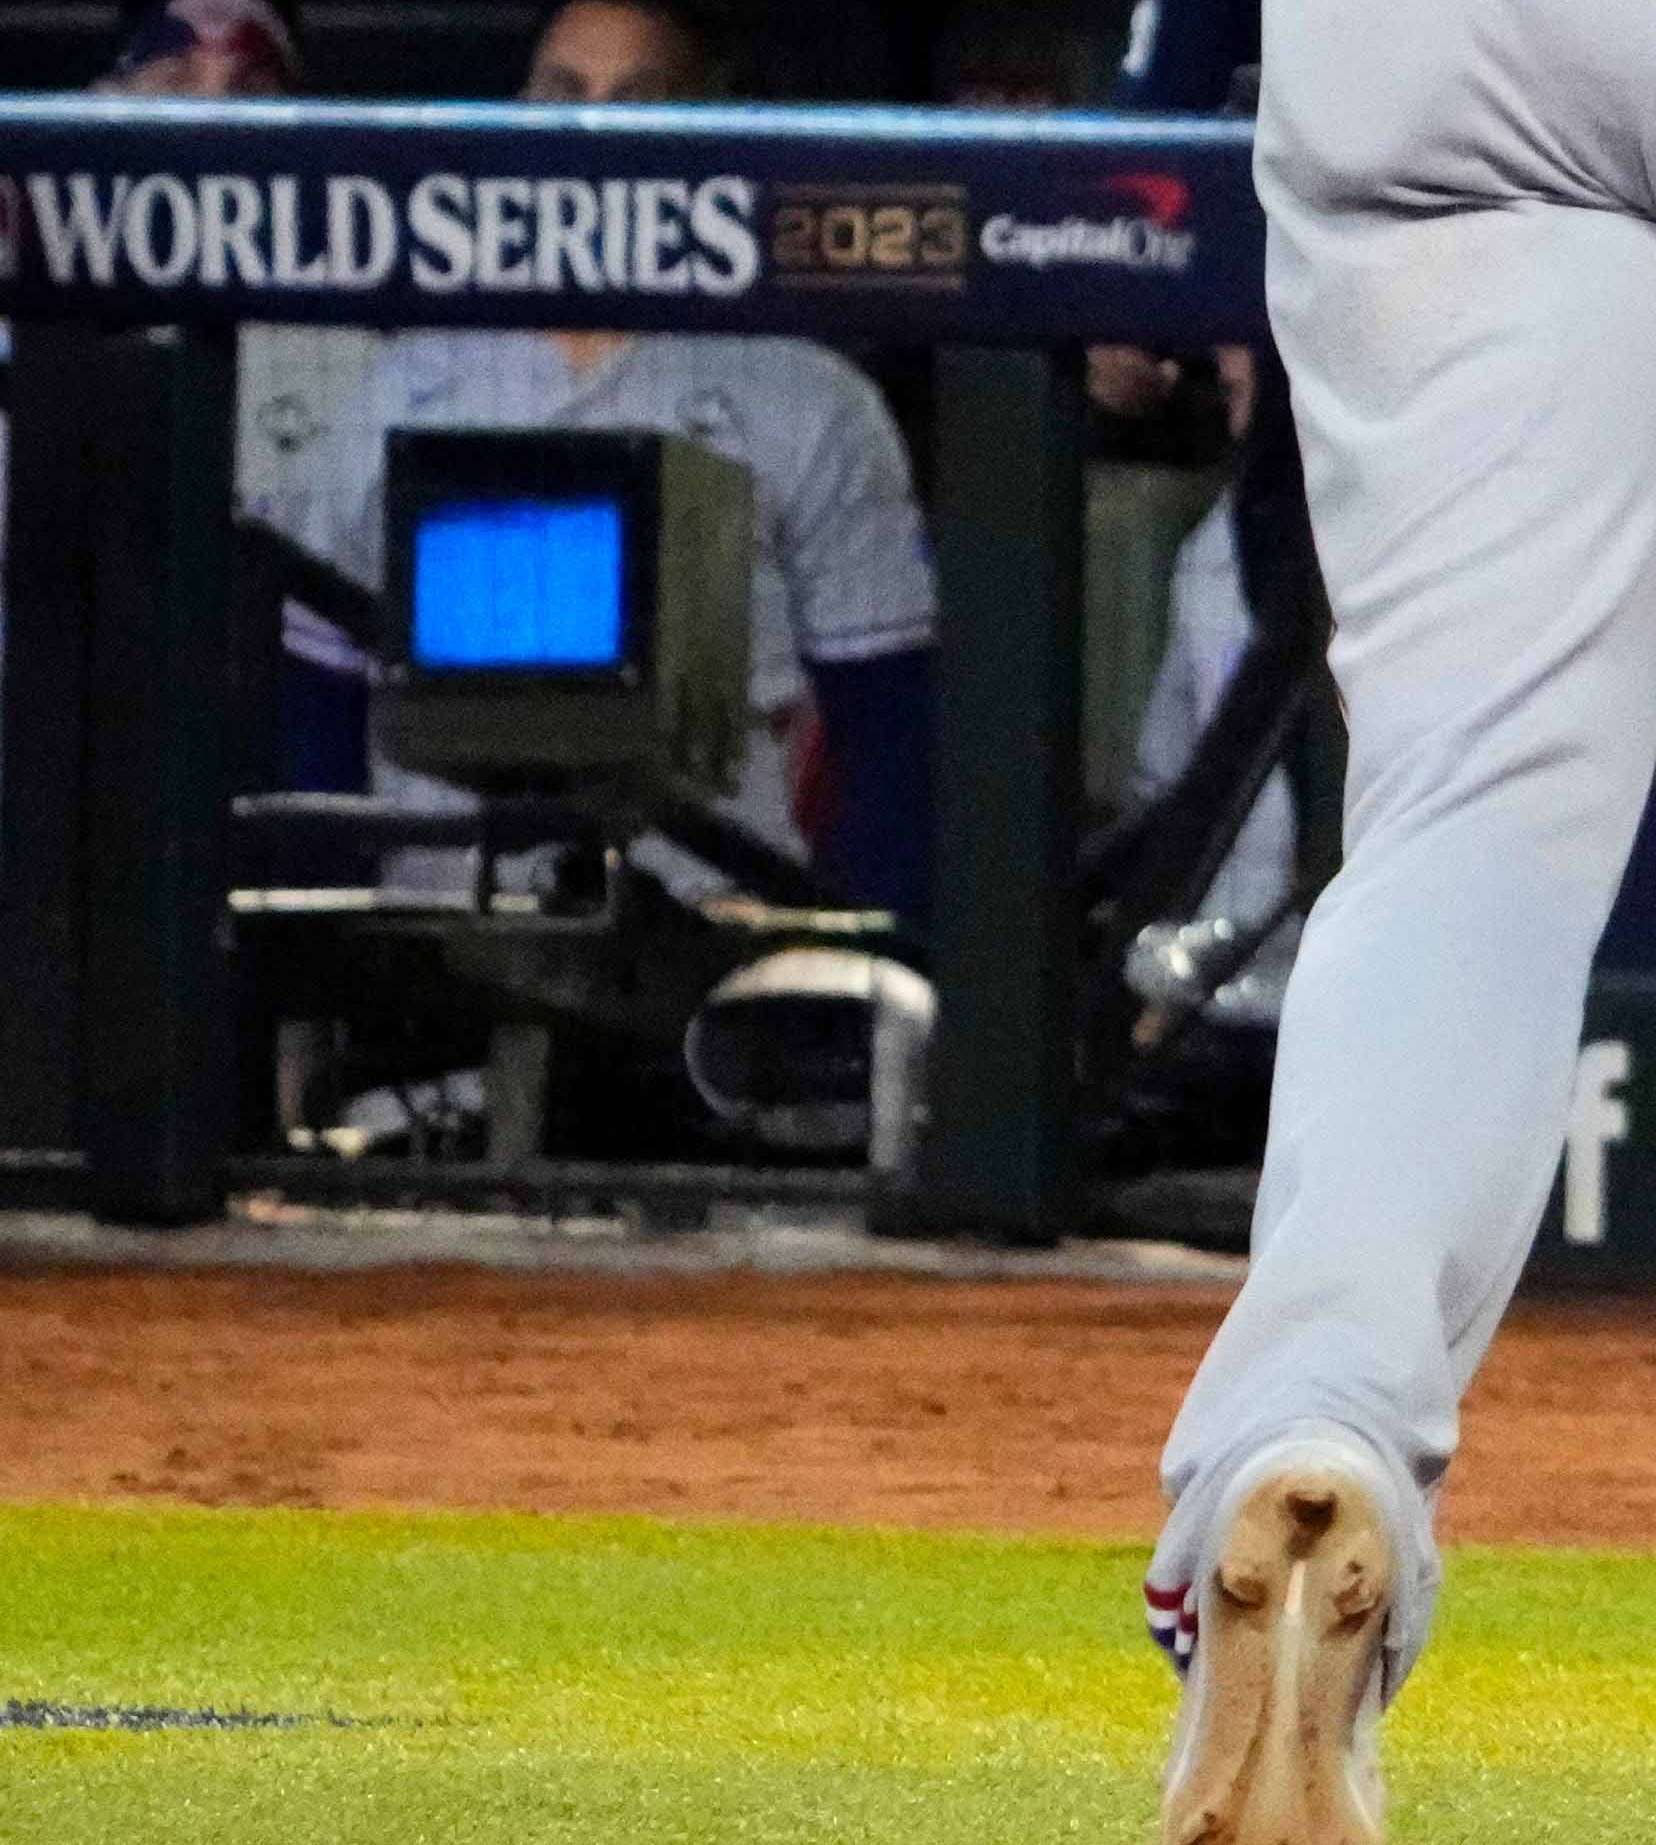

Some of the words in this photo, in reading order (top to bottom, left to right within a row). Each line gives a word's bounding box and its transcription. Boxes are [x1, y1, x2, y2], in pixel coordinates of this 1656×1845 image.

[26, 171, 398, 290] WORLD
[406, 173, 760, 296] SERIES
[772, 206, 966, 268] 2023
